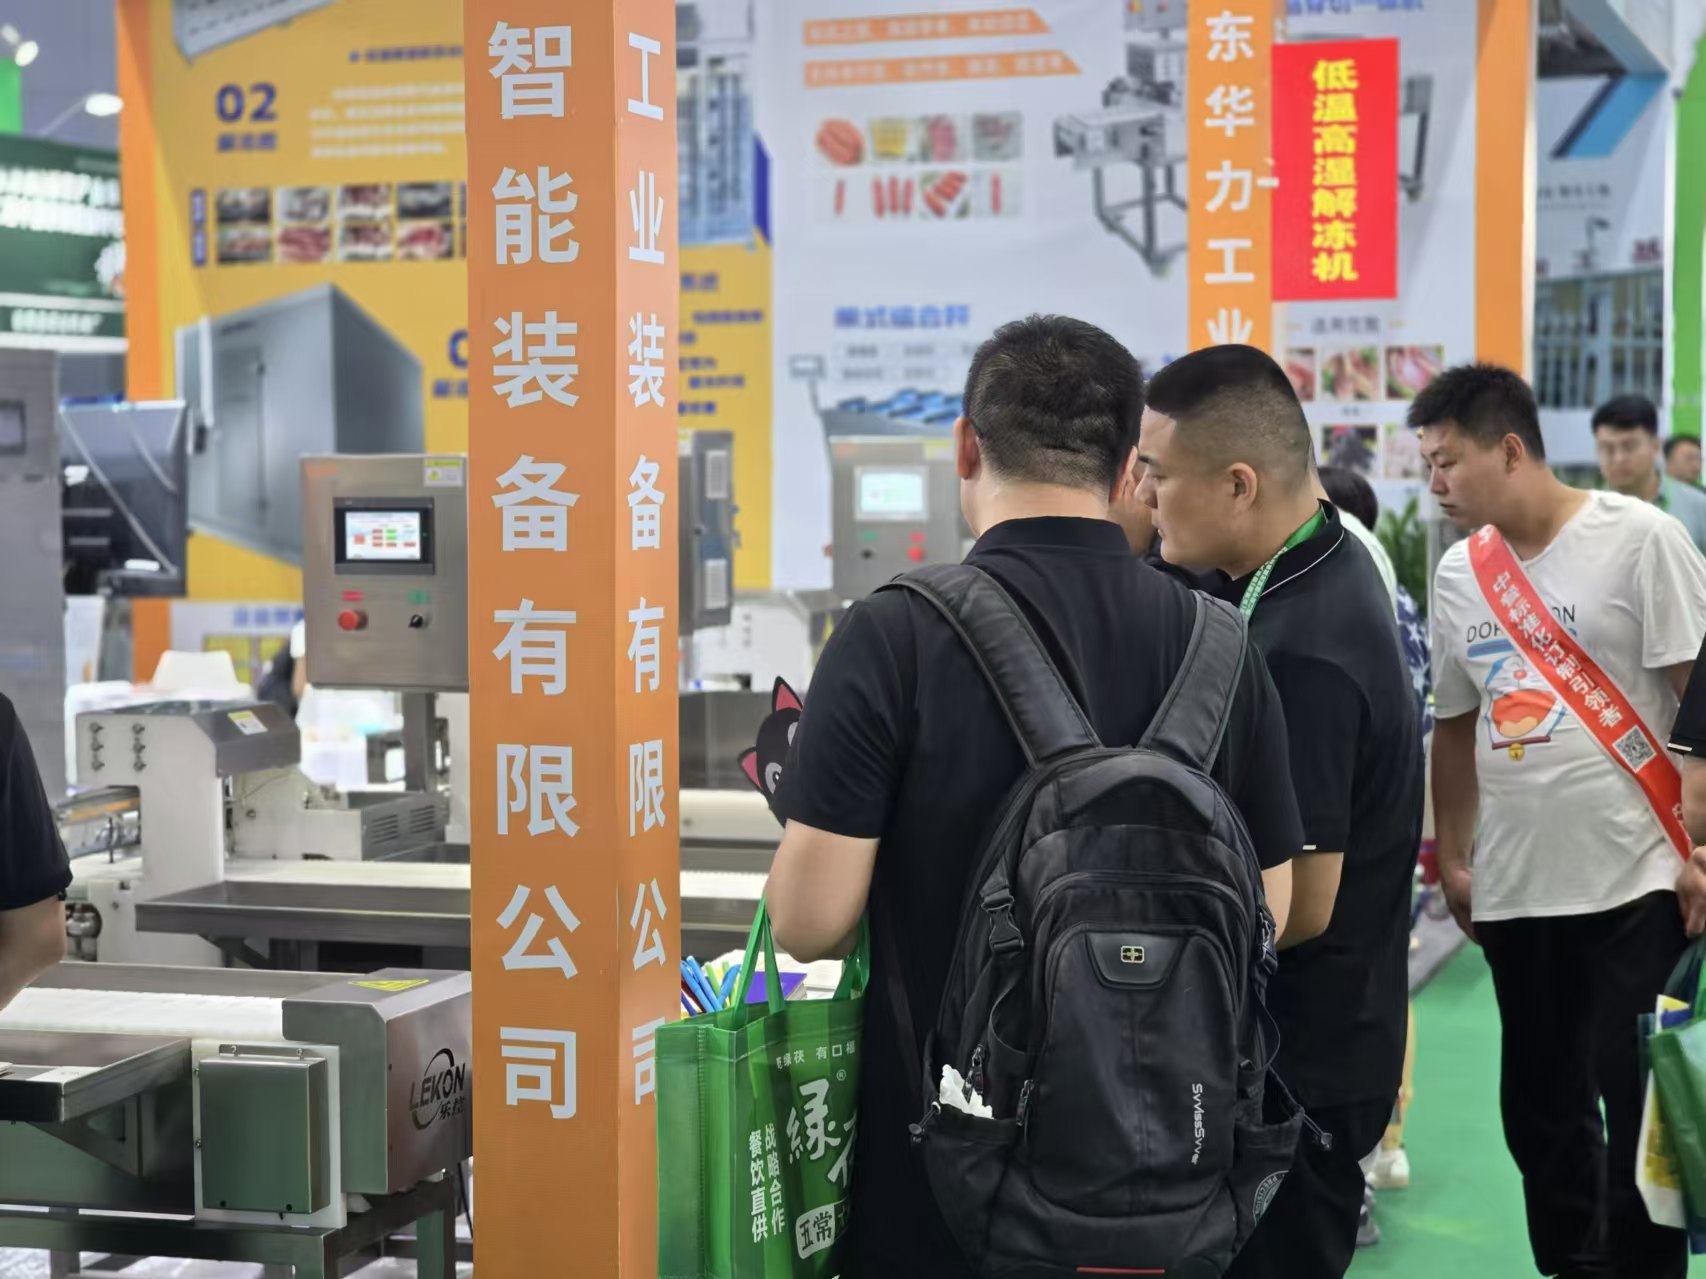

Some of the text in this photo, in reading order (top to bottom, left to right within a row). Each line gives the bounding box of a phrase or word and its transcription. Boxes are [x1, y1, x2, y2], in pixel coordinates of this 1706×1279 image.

[215, 82, 278, 123] 02
[1204, 10, 1255, 345] 东华力工业
[487, 21, 581, 1119] 智能装备有限公司
[627, 31, 668, 1105] 工业装备有限公司
[408, 1062, 466, 1111] LEKON
[815, 1040, 856, 1061] 有口福
[749, 1129, 769, 1244] 餐饮直供
[765, 1123, 786, 1236] 战略合作
